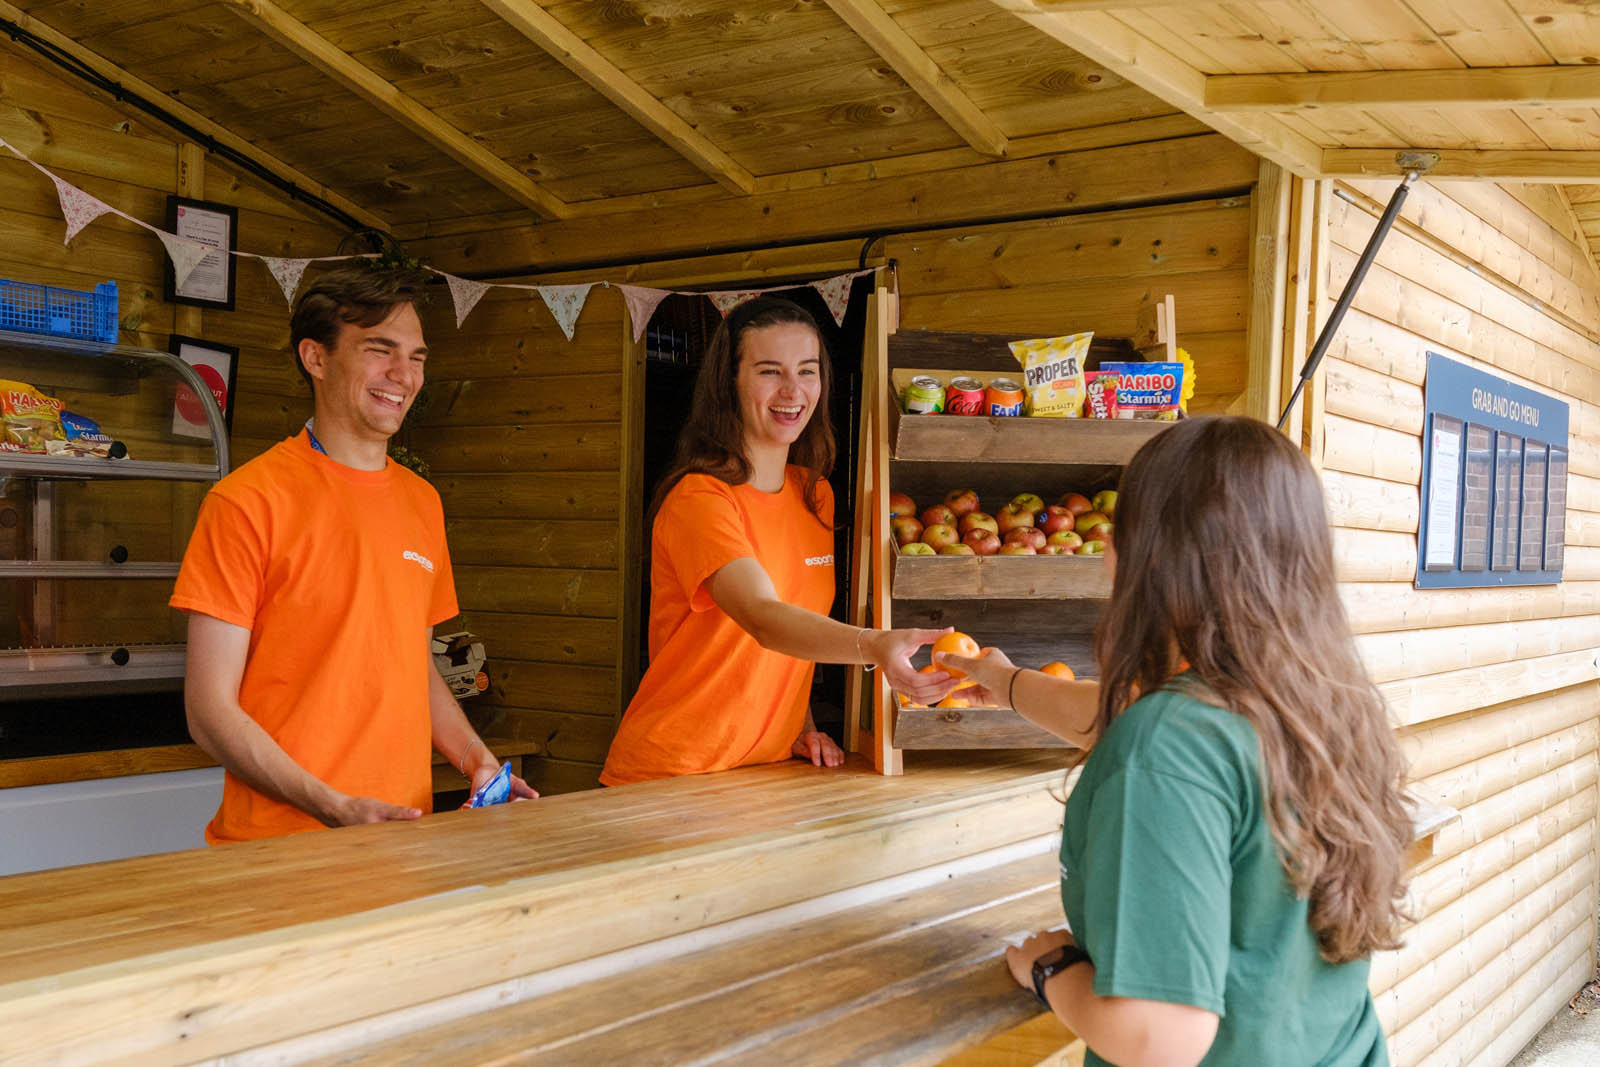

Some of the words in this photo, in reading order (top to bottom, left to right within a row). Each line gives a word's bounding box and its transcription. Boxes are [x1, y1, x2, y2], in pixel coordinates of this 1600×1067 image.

[1026, 357, 1078, 386] PROPER
[1119, 391, 1170, 406] Starmix
[1472, 387, 1492, 413] GRAB
[1492, 394, 1508, 418] AND
[1509, 400, 1520, 421] GO
[1521, 403, 1540, 427] MENU
